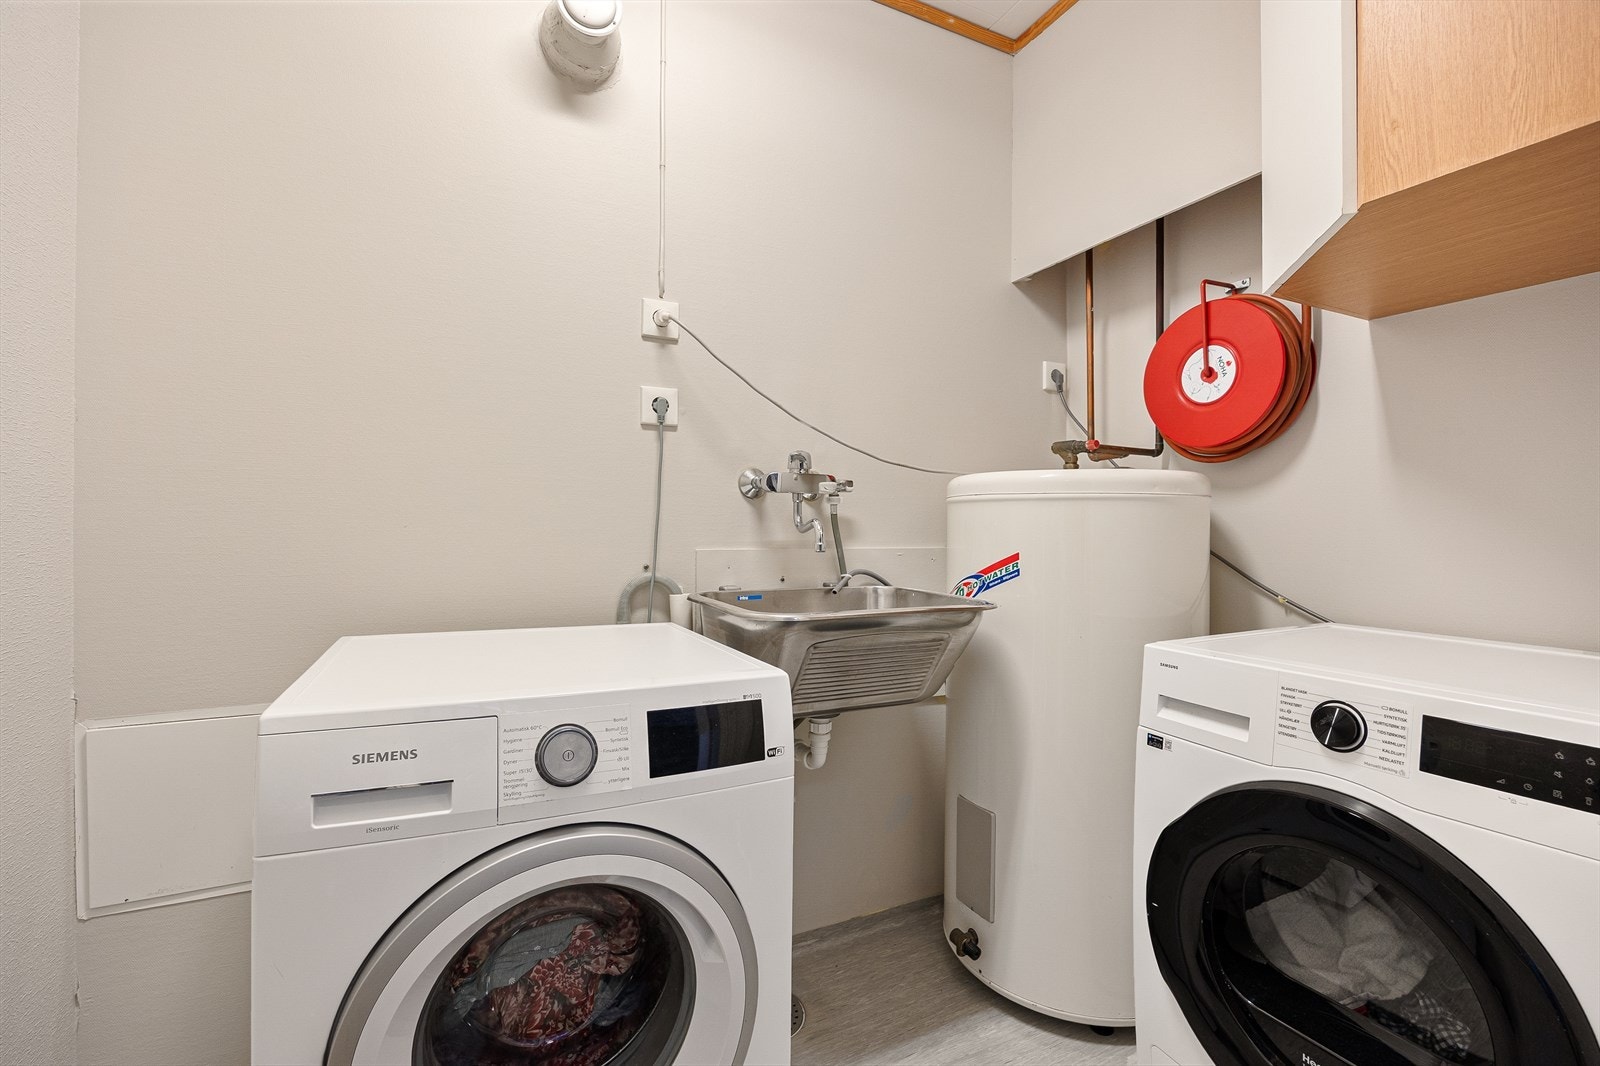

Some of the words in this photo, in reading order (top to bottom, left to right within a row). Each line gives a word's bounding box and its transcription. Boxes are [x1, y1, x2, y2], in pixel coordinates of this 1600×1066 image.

[1217, 355, 1228, 377] NOHA
[1159, 662, 1179, 670] SAMSUNG
[1389, 707, 1408, 715] BOMULL
[1384, 715, 1408, 723] SYNTETISK
[1373, 720, 1400, 729] HURTIGTØRK
[1278, 731, 1298, 739] UTENDØRS
[1377, 729, 1406, 739] TIDSTØRKING
[1381, 740, 1406, 748] VARMLUFT
[352, 749, 418, 765] SIEMENS
[1382, 749, 1405, 757] KALDLUFT
[1379, 757, 1405, 765] NEDLASTET
[365, 824, 400, 834] iSensoric
